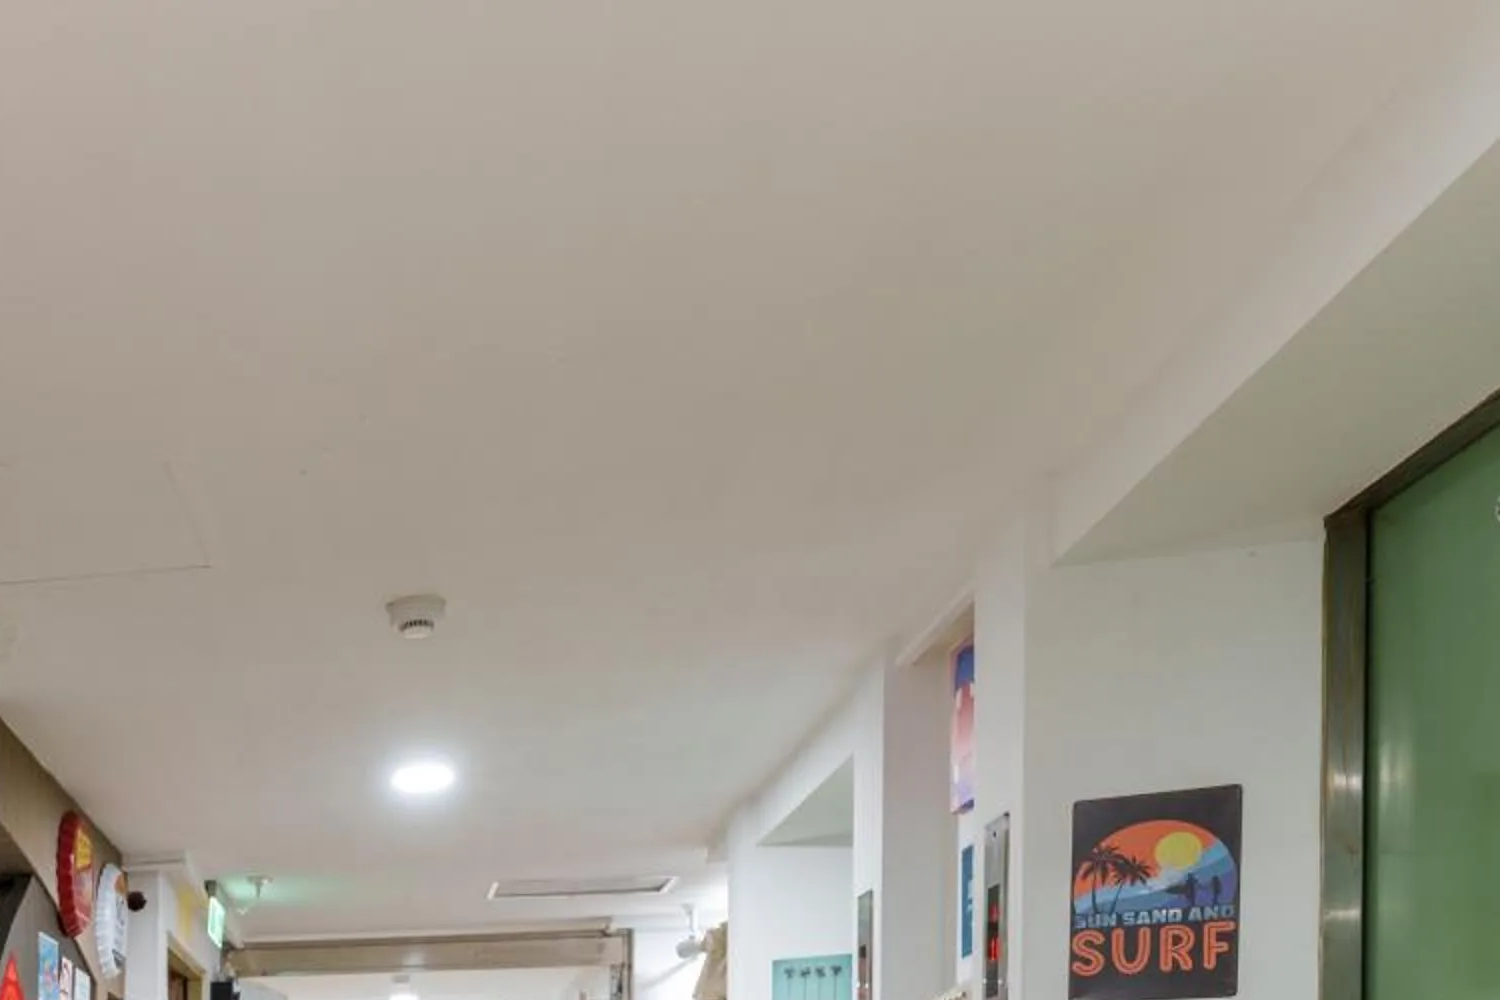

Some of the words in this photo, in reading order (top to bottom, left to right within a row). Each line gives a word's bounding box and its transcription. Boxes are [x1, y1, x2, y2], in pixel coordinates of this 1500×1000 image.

[1073, 911, 1117, 930] SUN
[1123, 907, 1182, 926] SAND
[1187, 903, 1236, 923] AND
[1071, 920, 1238, 978] SURF
